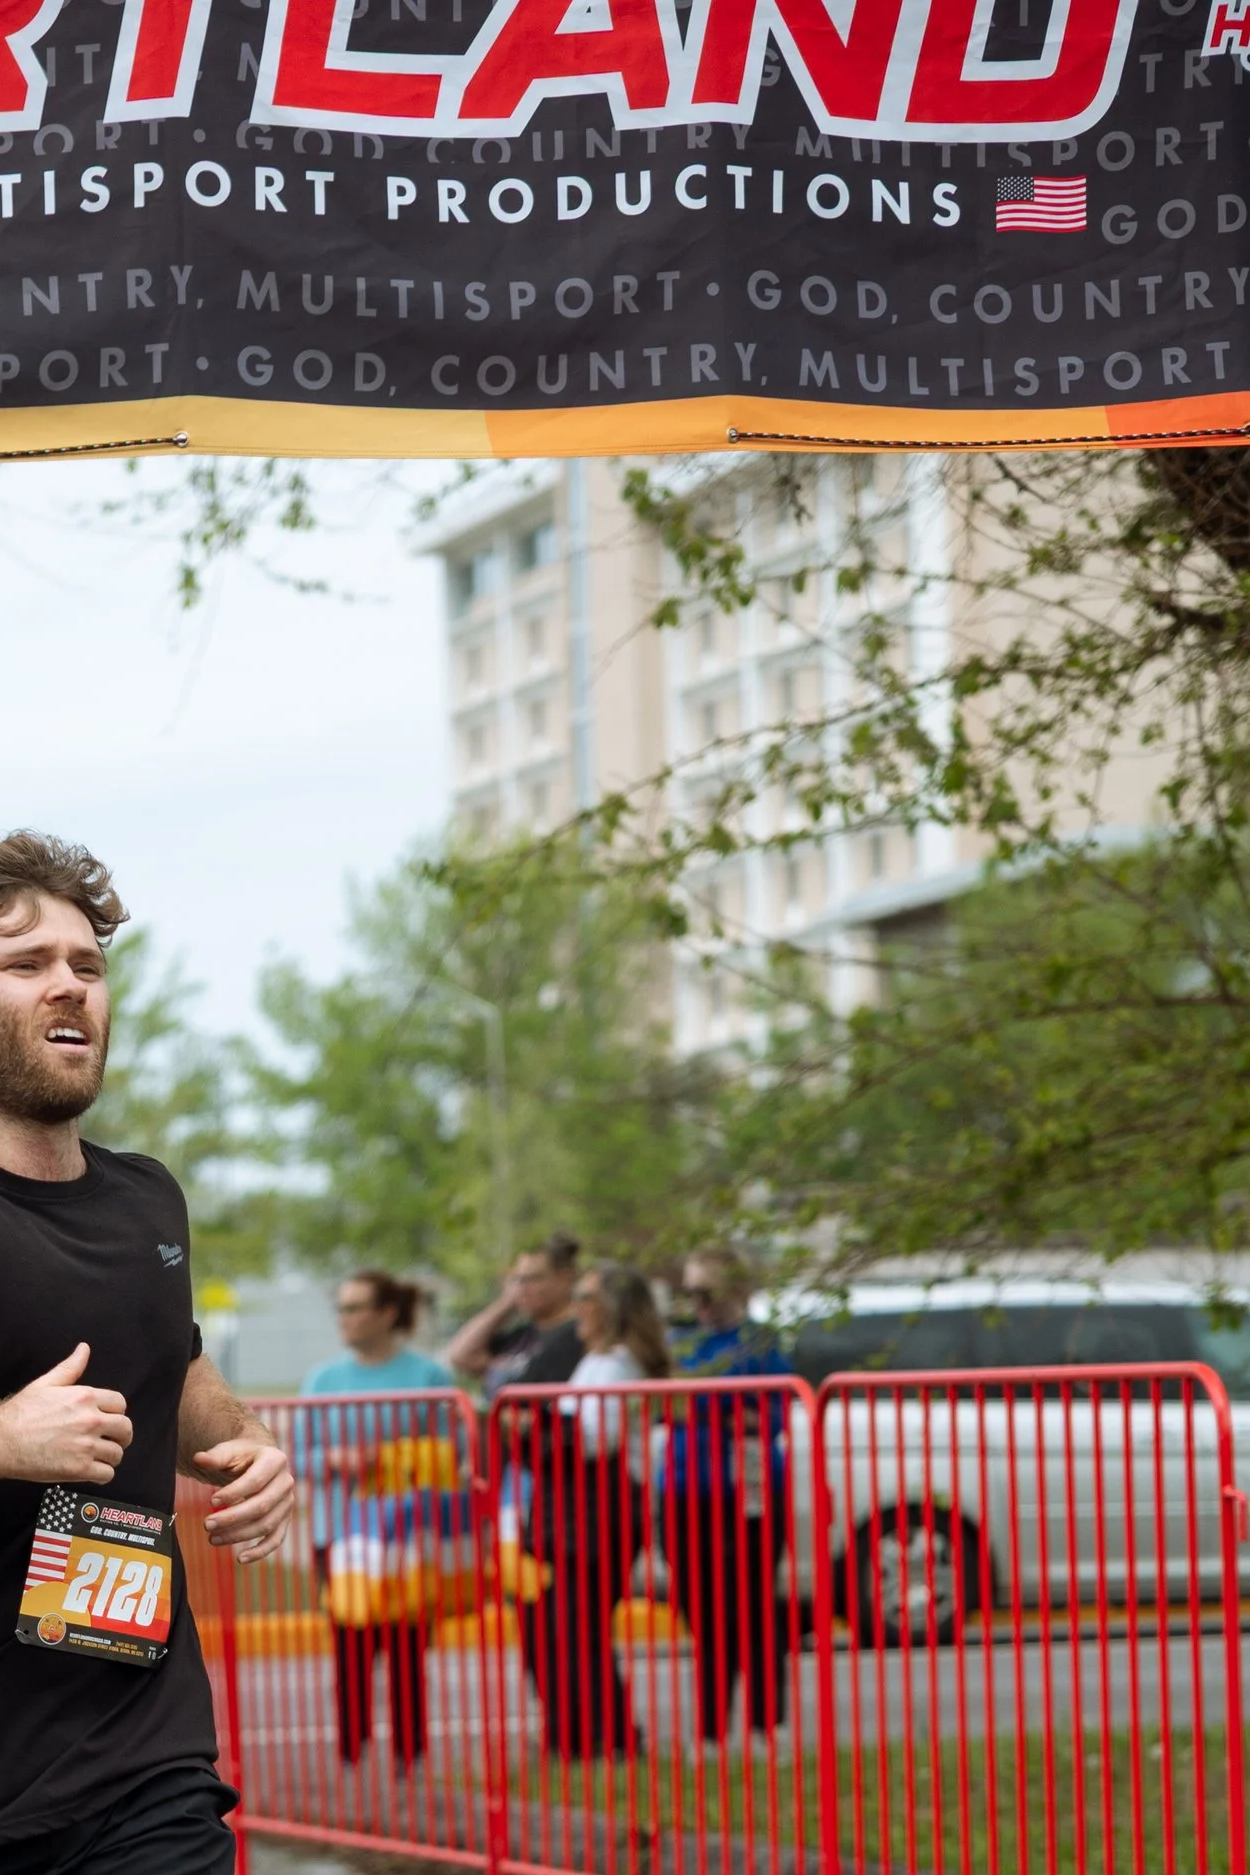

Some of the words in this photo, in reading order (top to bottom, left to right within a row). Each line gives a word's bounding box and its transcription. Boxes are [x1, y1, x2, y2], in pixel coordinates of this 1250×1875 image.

[386, 164, 961, 227] PRODUCTIONS
[237, 269, 681, 321] MULTISPORT
[747, 269, 897, 324] GOD,
[930, 267, 1250, 324] COUNTRY
[237, 345, 396, 397] GOD,
[431, 342, 768, 396] COUNTRY,
[799, 341, 1231, 395] MULTISPORT
[100, 1507, 163, 1531] HEARTLAND
[62, 1552, 163, 1627] 2128
